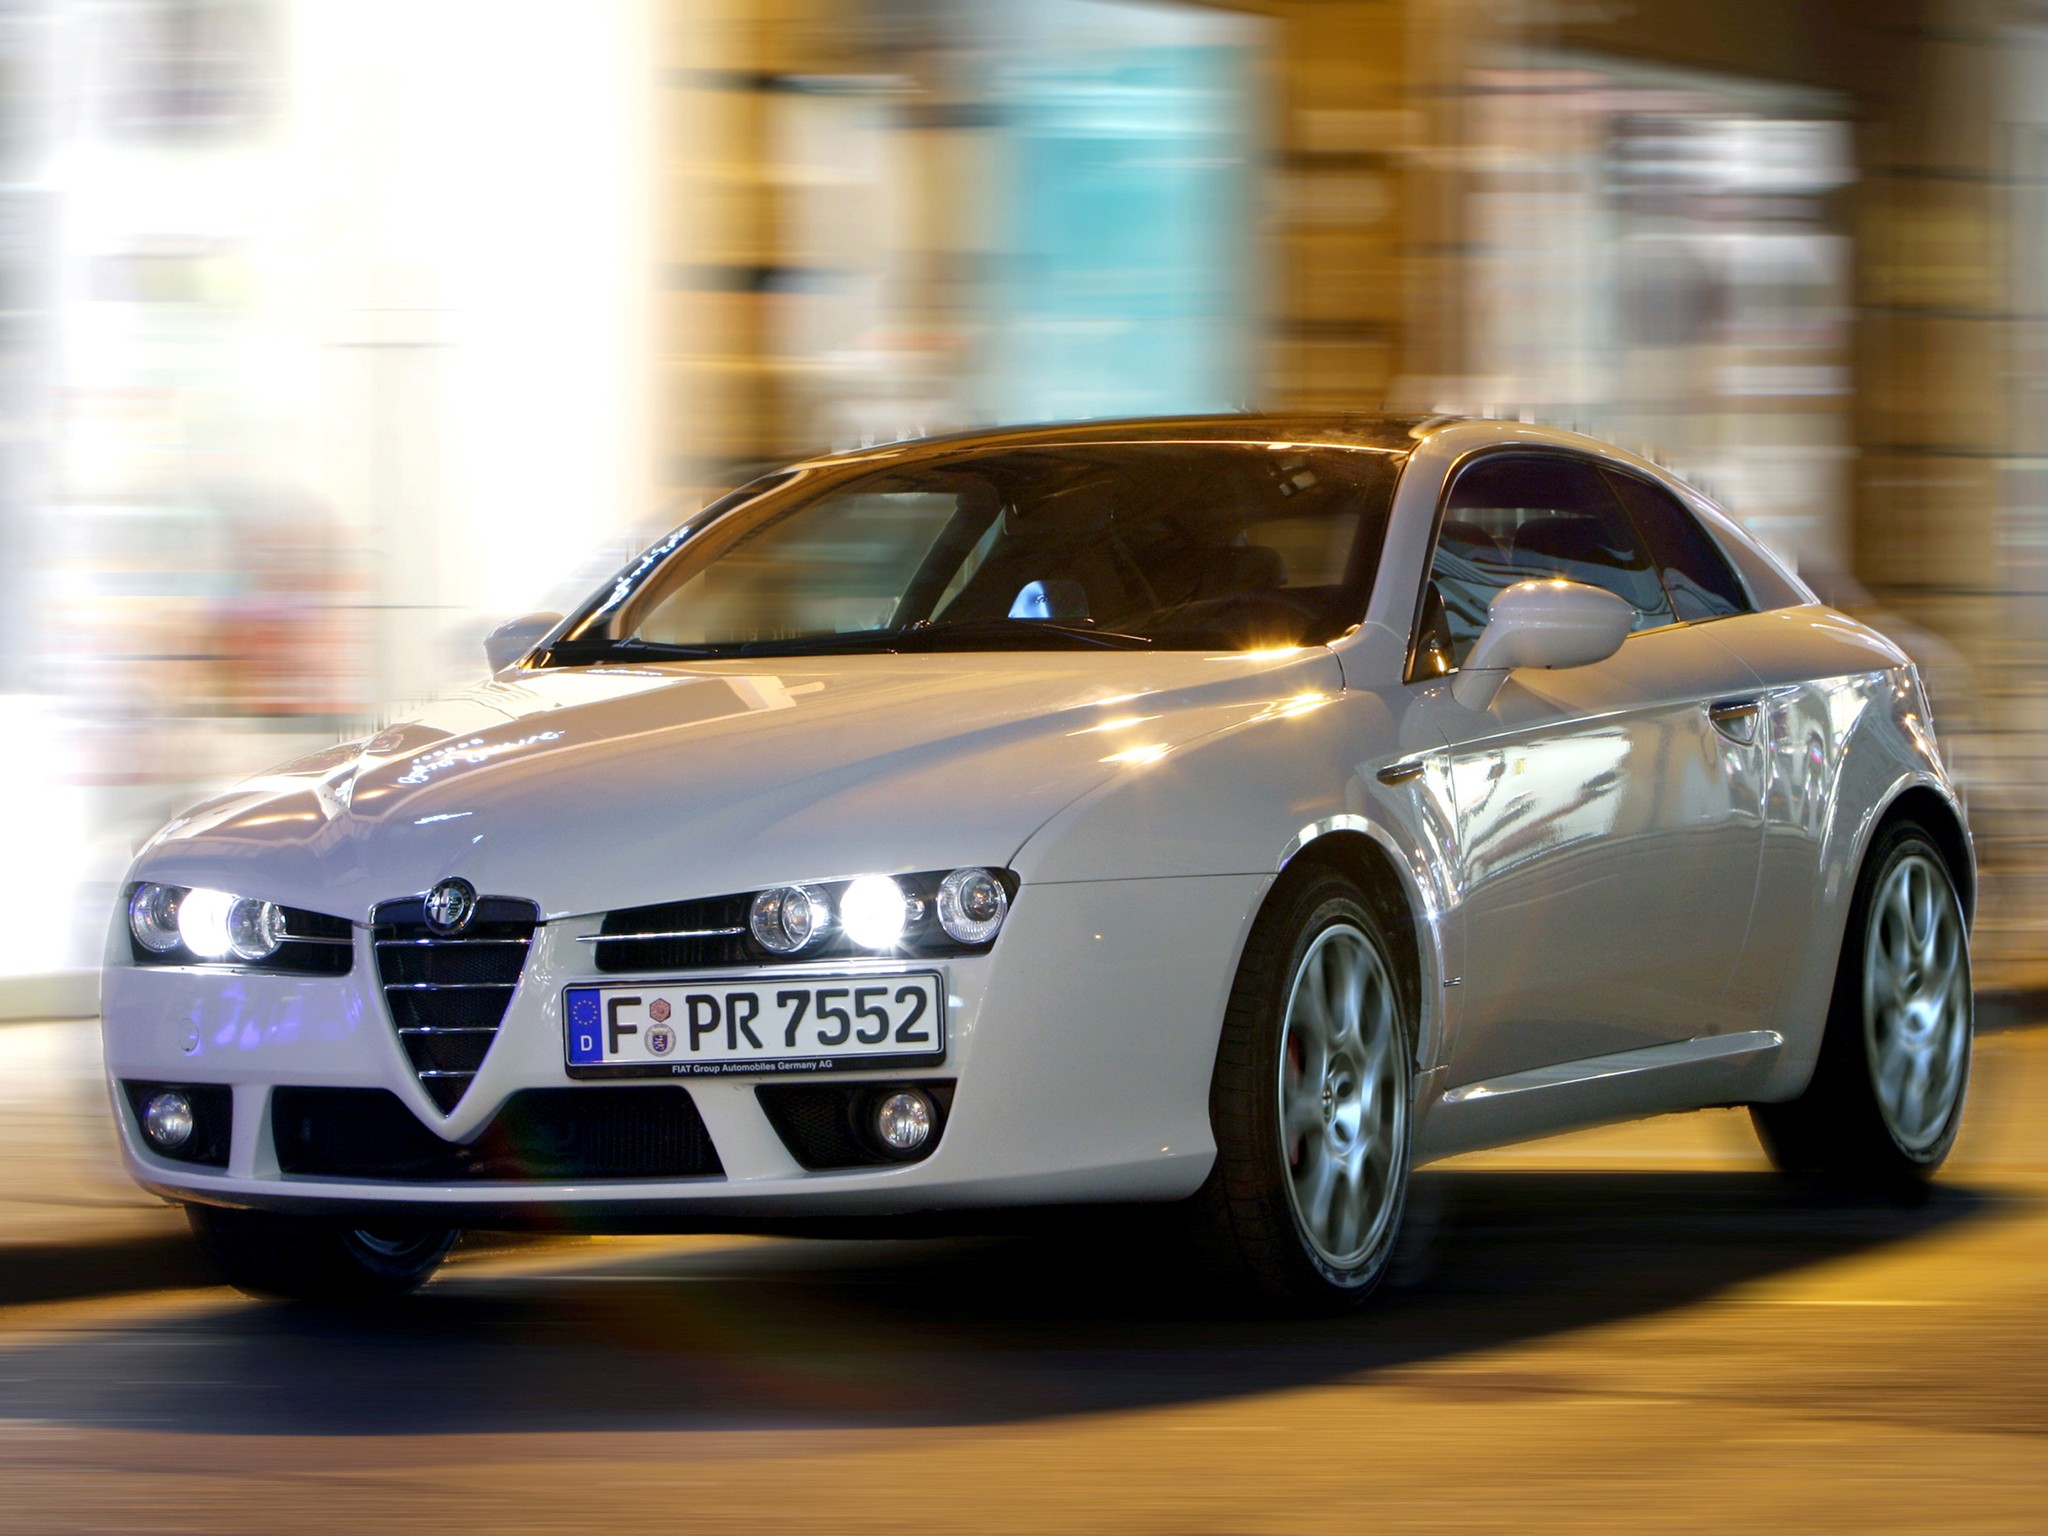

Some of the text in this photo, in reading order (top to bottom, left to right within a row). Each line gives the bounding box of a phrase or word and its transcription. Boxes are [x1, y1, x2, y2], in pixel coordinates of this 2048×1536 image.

[607, 986, 930, 1054] F PR 7552
[580, 1035, 593, 1051] D
[672, 1060, 833, 1074] FIAT Group Automobiles Germany AG
